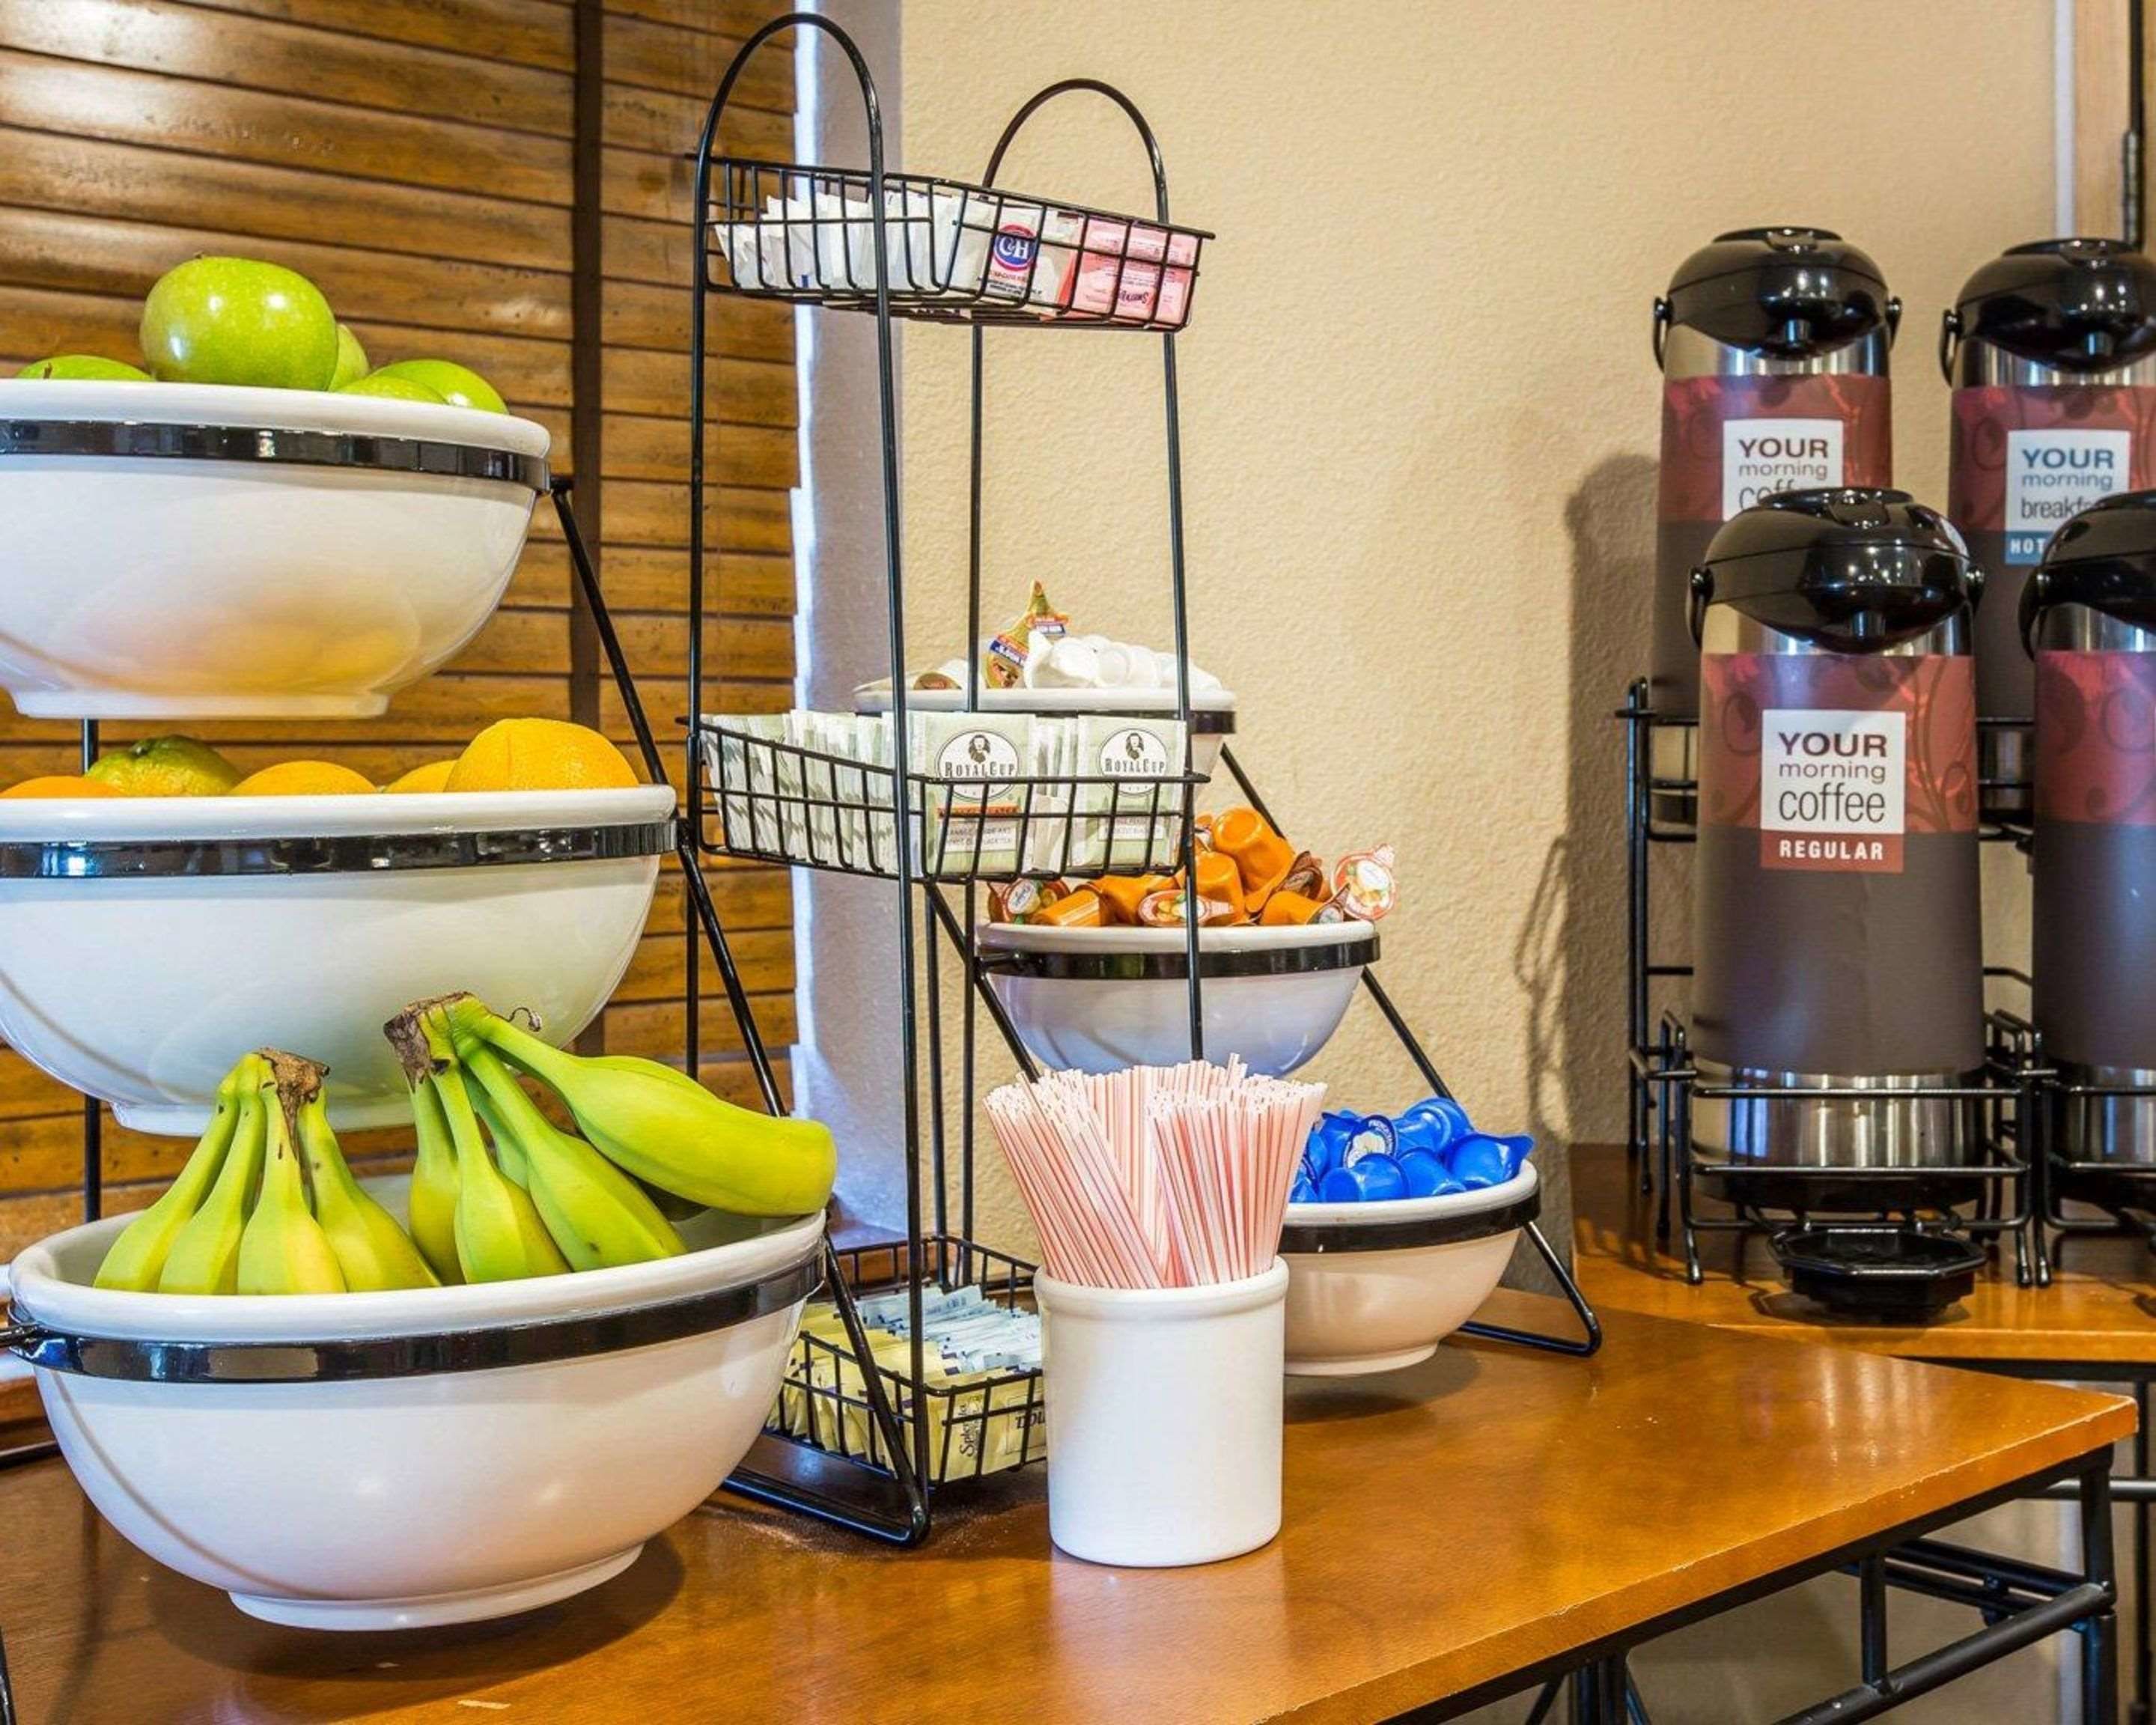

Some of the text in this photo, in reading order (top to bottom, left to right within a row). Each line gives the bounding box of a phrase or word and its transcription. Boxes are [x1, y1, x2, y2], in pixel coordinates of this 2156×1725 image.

[1738, 438, 1828, 458] YOUR
[2022, 448, 2114, 469] YOUR
[1739, 460, 1828, 481] morning
[2022, 472, 2113, 490] morning
[2022, 496, 2095, 519] breakf
[2009, 538, 2046, 554] HOT
[1778, 732, 1887, 758] YOUR
[1779, 761, 1886, 785] morning
[1779, 782, 1886, 823] coffee
[1779, 839, 1884, 860] REGULAR
